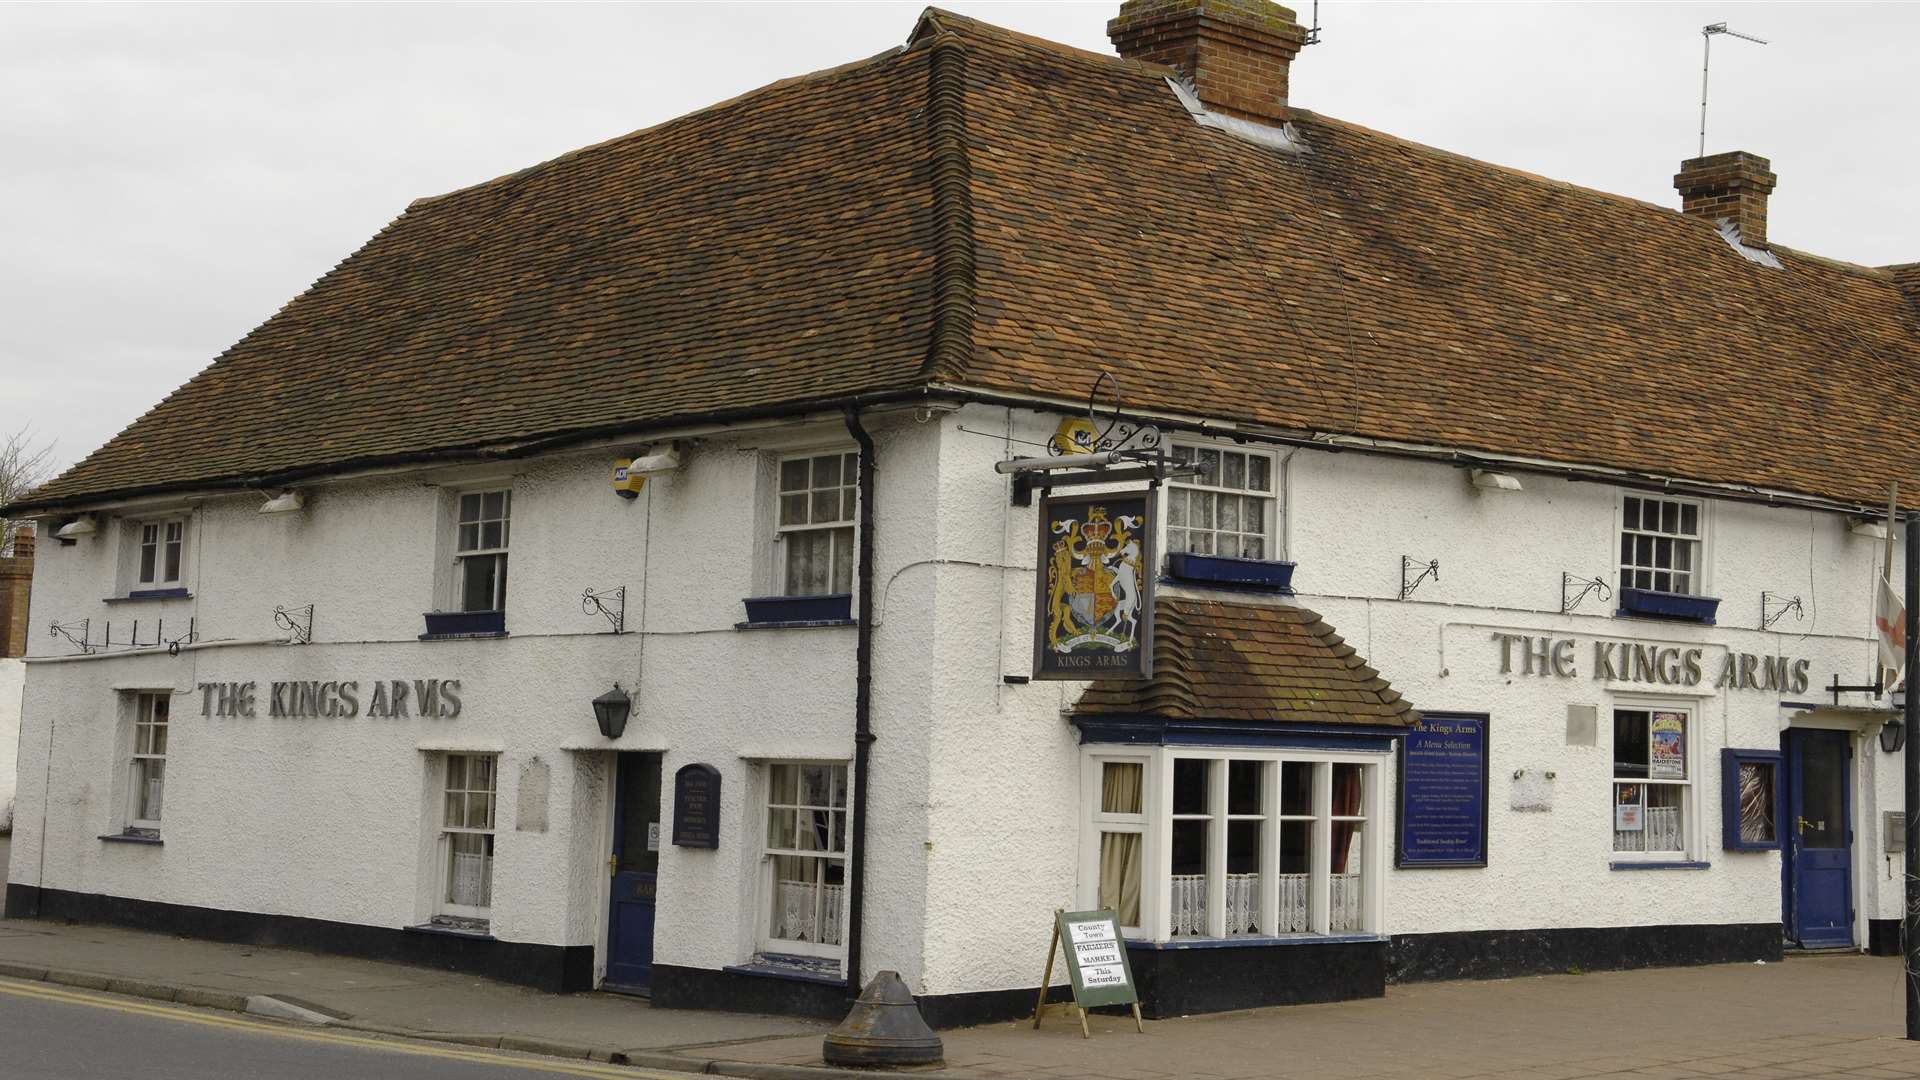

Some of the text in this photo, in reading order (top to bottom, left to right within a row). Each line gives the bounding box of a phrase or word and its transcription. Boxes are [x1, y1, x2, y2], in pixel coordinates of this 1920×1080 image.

[1057, 654, 1128, 667] KINGS ARMS
[1491, 631, 1811, 695] THE KINGS ARMS
[197, 678, 463, 719] THE KINGS ARMS
[1429, 722, 1453, 735] Kings
[1455, 724, 1476, 733] Arms
[1416, 739, 1472, 750] A Menu Selection
[1078, 924, 1105, 932] County
[1083, 955, 1116, 963] MARKET
[1087, 975, 1121, 984] Saturday
